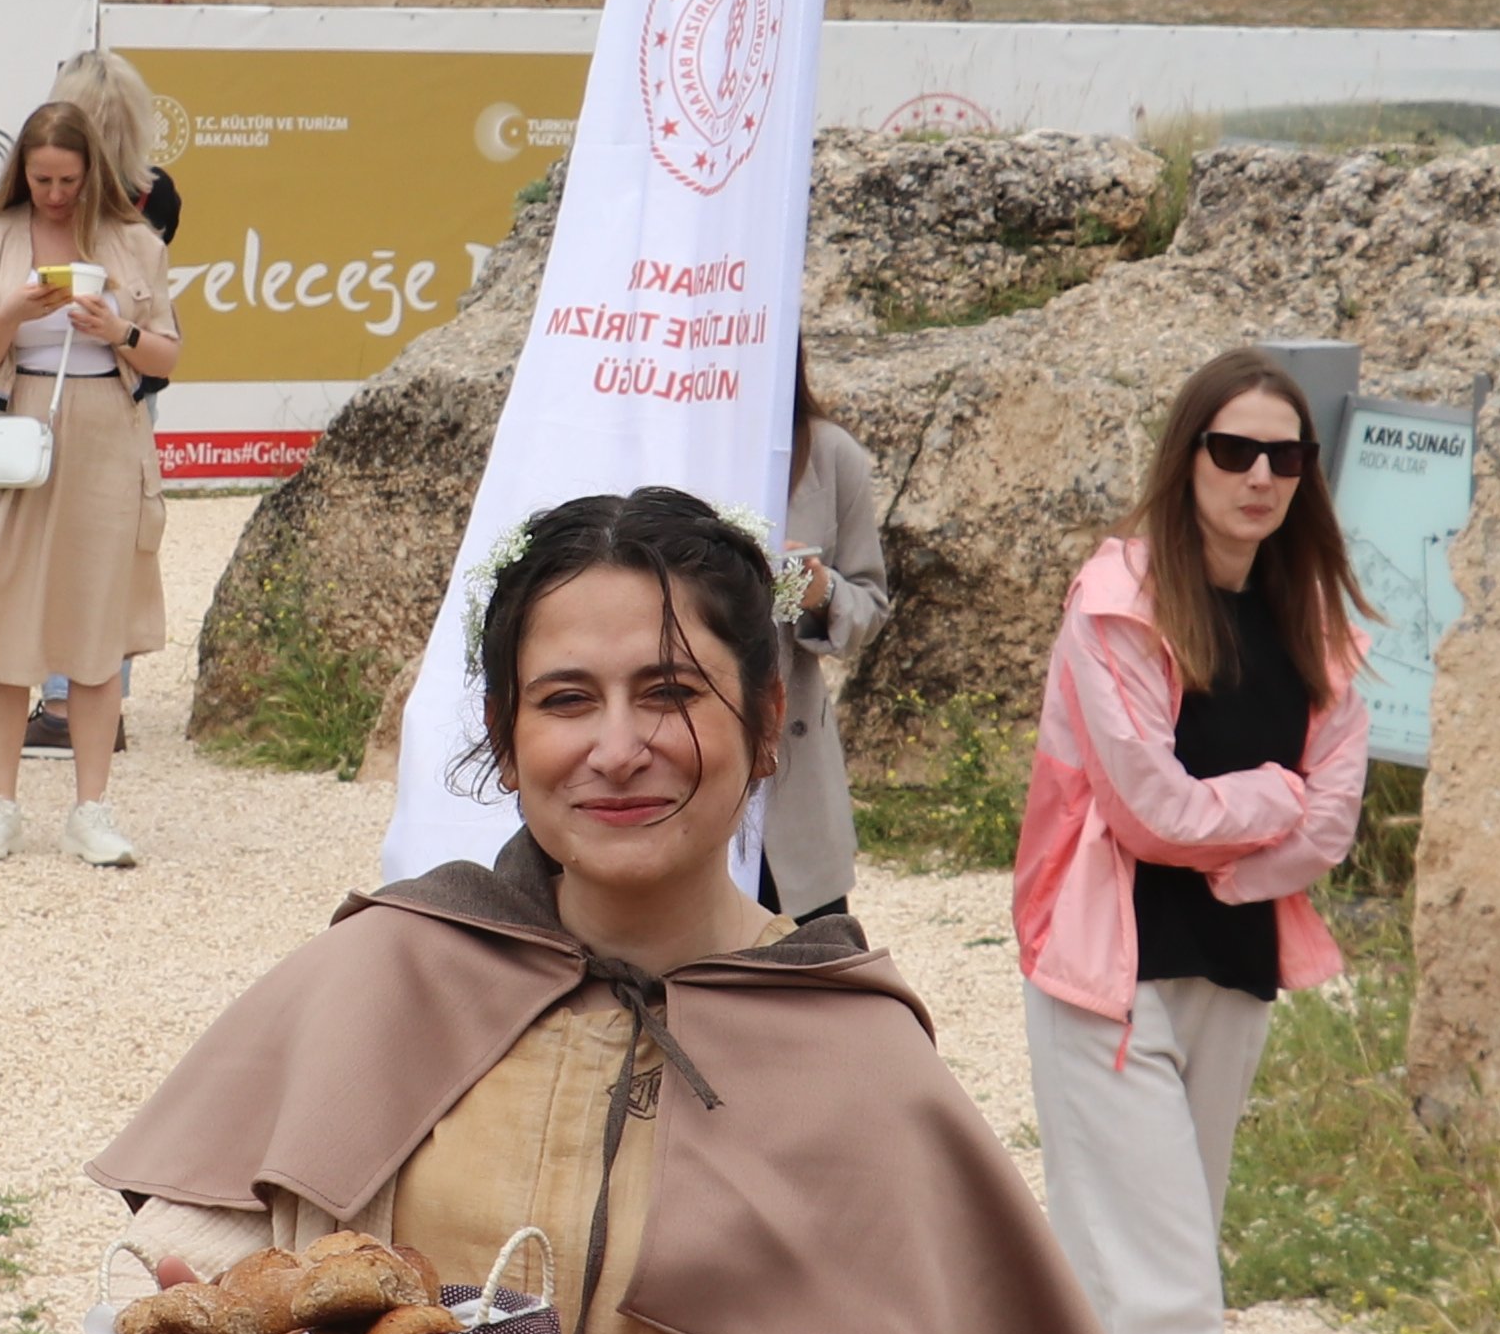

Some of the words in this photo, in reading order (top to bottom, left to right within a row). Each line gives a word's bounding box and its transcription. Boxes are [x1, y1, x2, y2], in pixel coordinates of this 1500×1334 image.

[195, 116, 219, 130] T.C.
[220, 112, 274, 130] KÜLTÜR
[276, 116, 295, 131] VE
[194, 130, 270, 147] BAKANLIĞI
[1363, 424, 1403, 450] KAYA
[1405, 430, 1467, 458] SUNAĞI
[1358, 450, 1390, 470] ROCK
[1391, 455, 1429, 476] ALTAR
